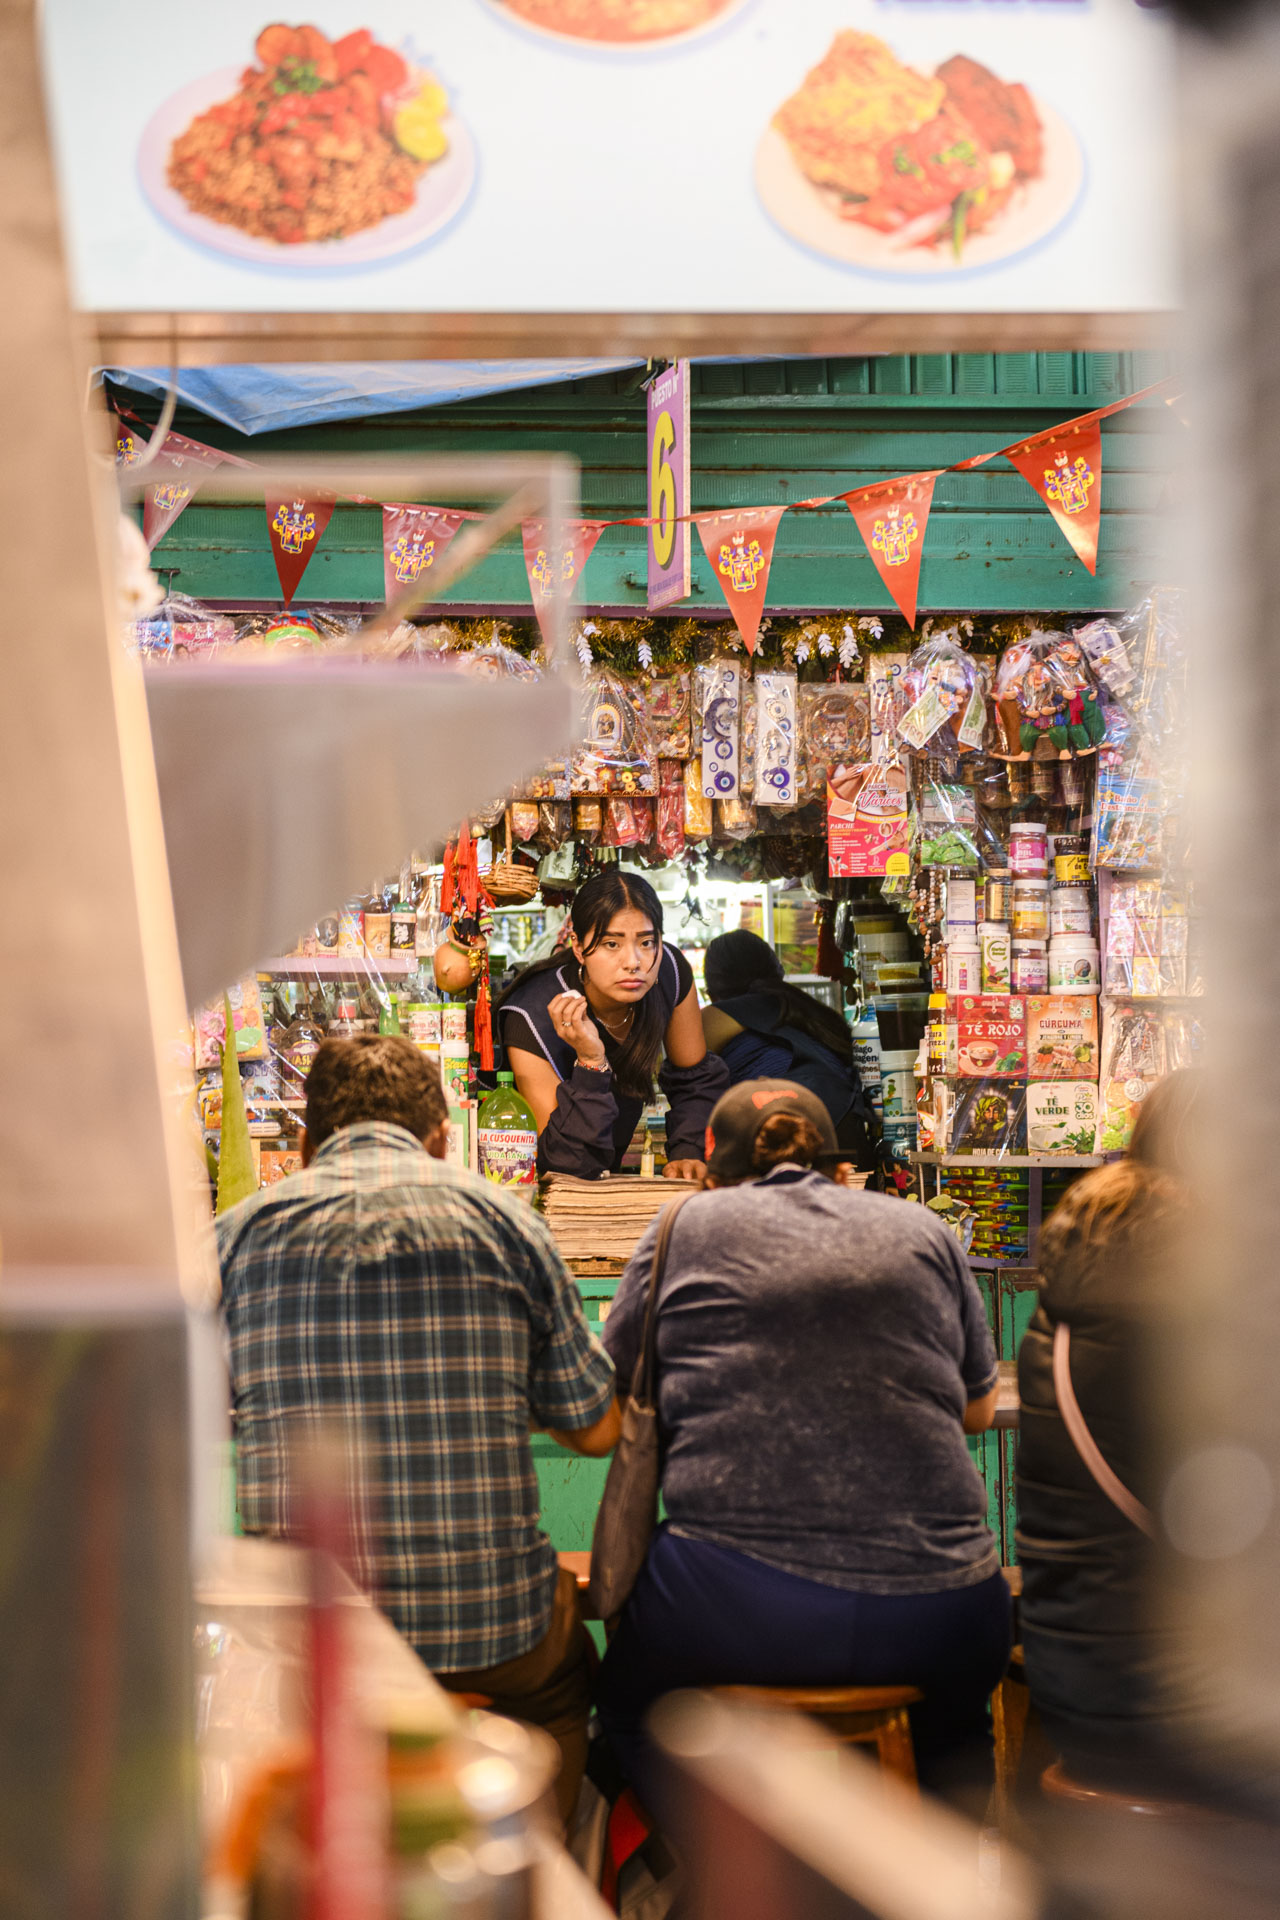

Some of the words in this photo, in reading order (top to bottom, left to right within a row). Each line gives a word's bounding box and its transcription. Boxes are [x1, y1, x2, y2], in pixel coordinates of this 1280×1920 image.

[651, 379, 672, 410] PUESTO
[651, 411, 676, 567] 6
[965, 1021, 983, 1036] TÉ
[988, 1024, 1021, 1036] ROJO
[1046, 1096, 1059, 1106] TÉ
[1035, 1107, 1069, 1116] VERDE
[480, 1133, 488, 1142] LA
[487, 1151, 506, 1160] VIDA
[507, 1151, 528, 1160] SANA
[972, 1147, 987, 1157] HOJA
[987, 1148, 995, 1157] DE
